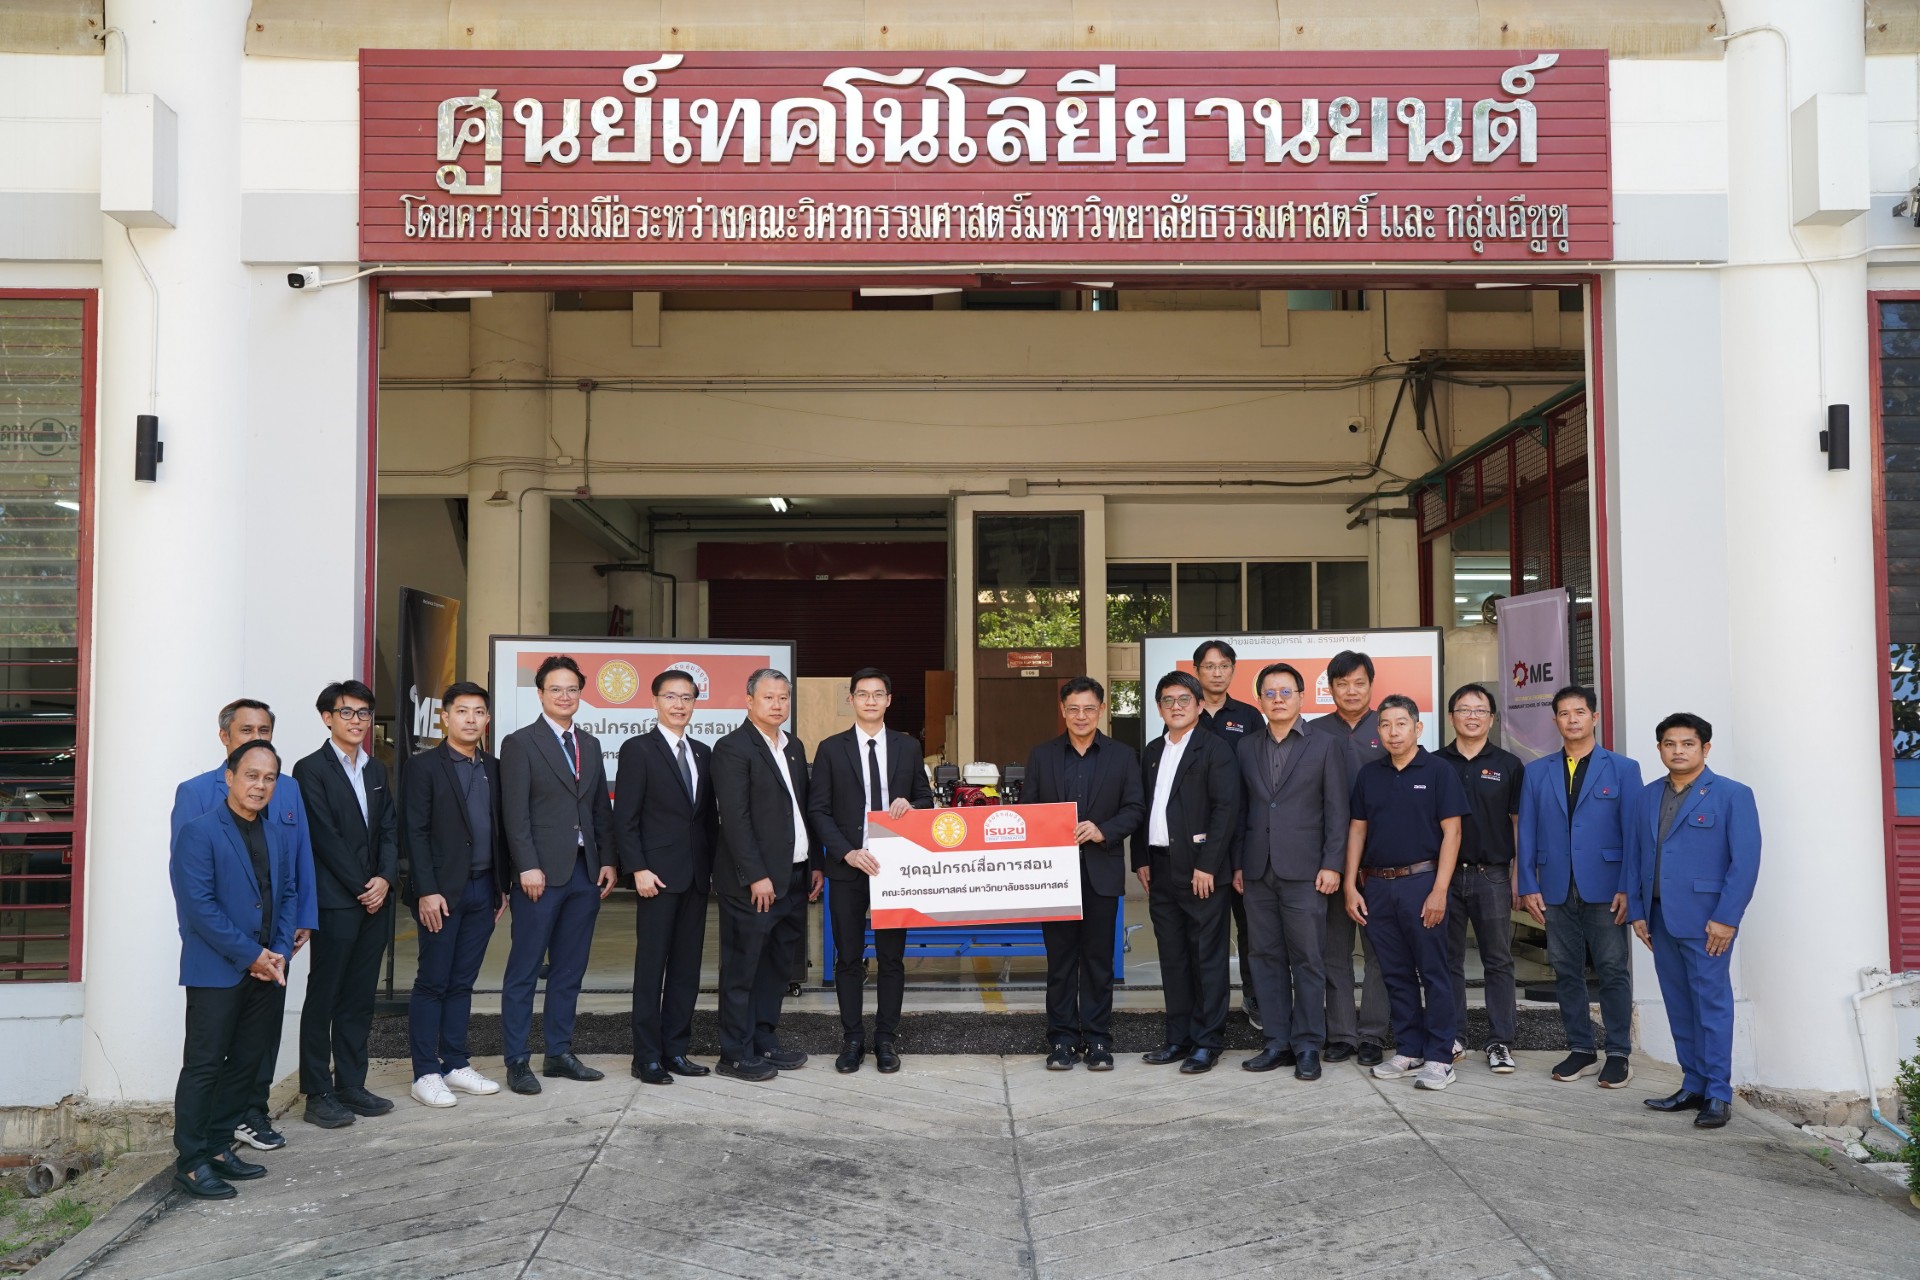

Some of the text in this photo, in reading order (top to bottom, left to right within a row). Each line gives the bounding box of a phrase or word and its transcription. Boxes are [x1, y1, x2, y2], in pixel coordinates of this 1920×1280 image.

[436, 53, 1560, 195] ศูนย์เทคโนโลยียานยนต์
[1381, 203, 1436, 239] และ
[1446, 193, 1569, 254] กลุ่มอีซูซุ
[1530, 662, 1554, 684] ME
[985, 827, 1025, 836] ISUZU
[899, 855, 1053, 879] ชุดอุปกรณ์สื่อการสอน
[881, 879, 1069, 897] คณะวิศวกรรมศาสตร์ มหาวิทยาลัยธรรมศาสตร์
